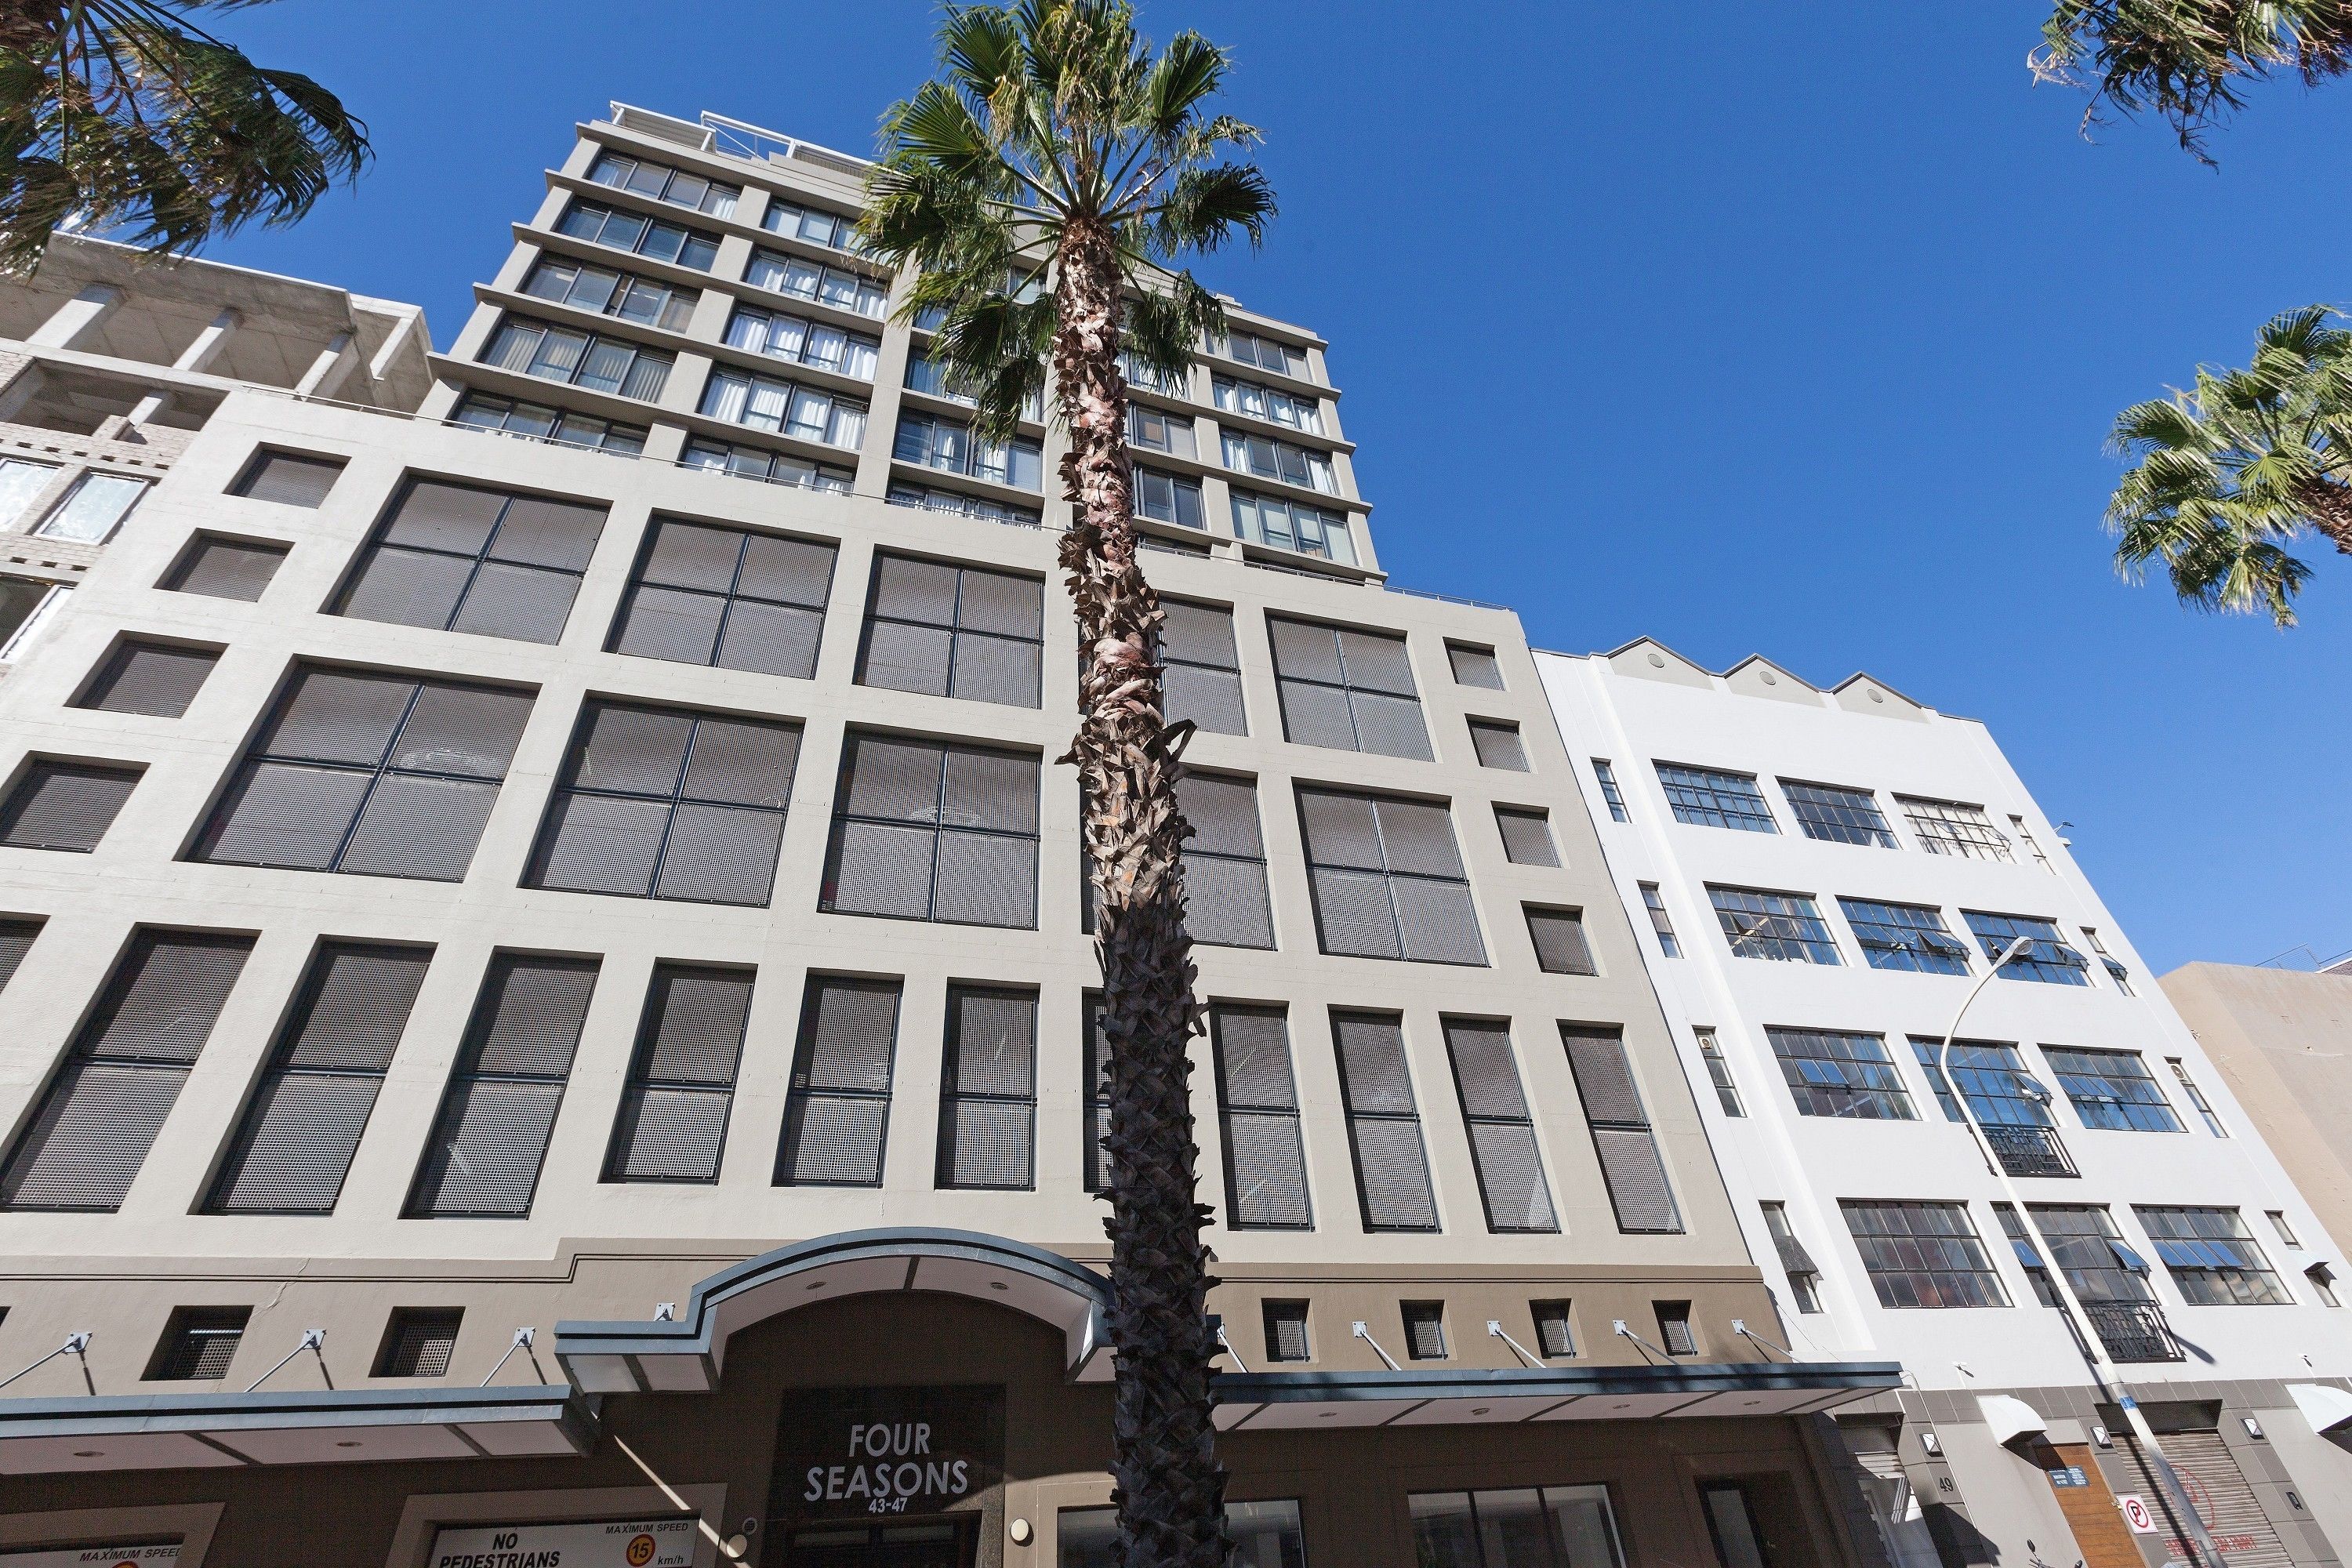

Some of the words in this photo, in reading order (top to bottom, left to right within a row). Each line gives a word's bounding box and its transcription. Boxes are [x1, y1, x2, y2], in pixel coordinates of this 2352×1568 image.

[848, 1422, 931, 1457] FOUR
[804, 1460, 968, 1501] SEASONS
[1940, 1477, 1954, 1491] 49
[868, 1497, 908, 1513] 43-47
[605, 1524, 654, 1534] MAXIMUM
[657, 1523, 688, 1532] SPEED
[492, 1533, 518, 1550] NO
[79, 1549, 141, 1562] MAXIMUM
[632, 1542, 650, 1558] 15
[438, 1551, 561, 1568] PEDESTRIANS
[657, 1555, 684, 1565] km/h
